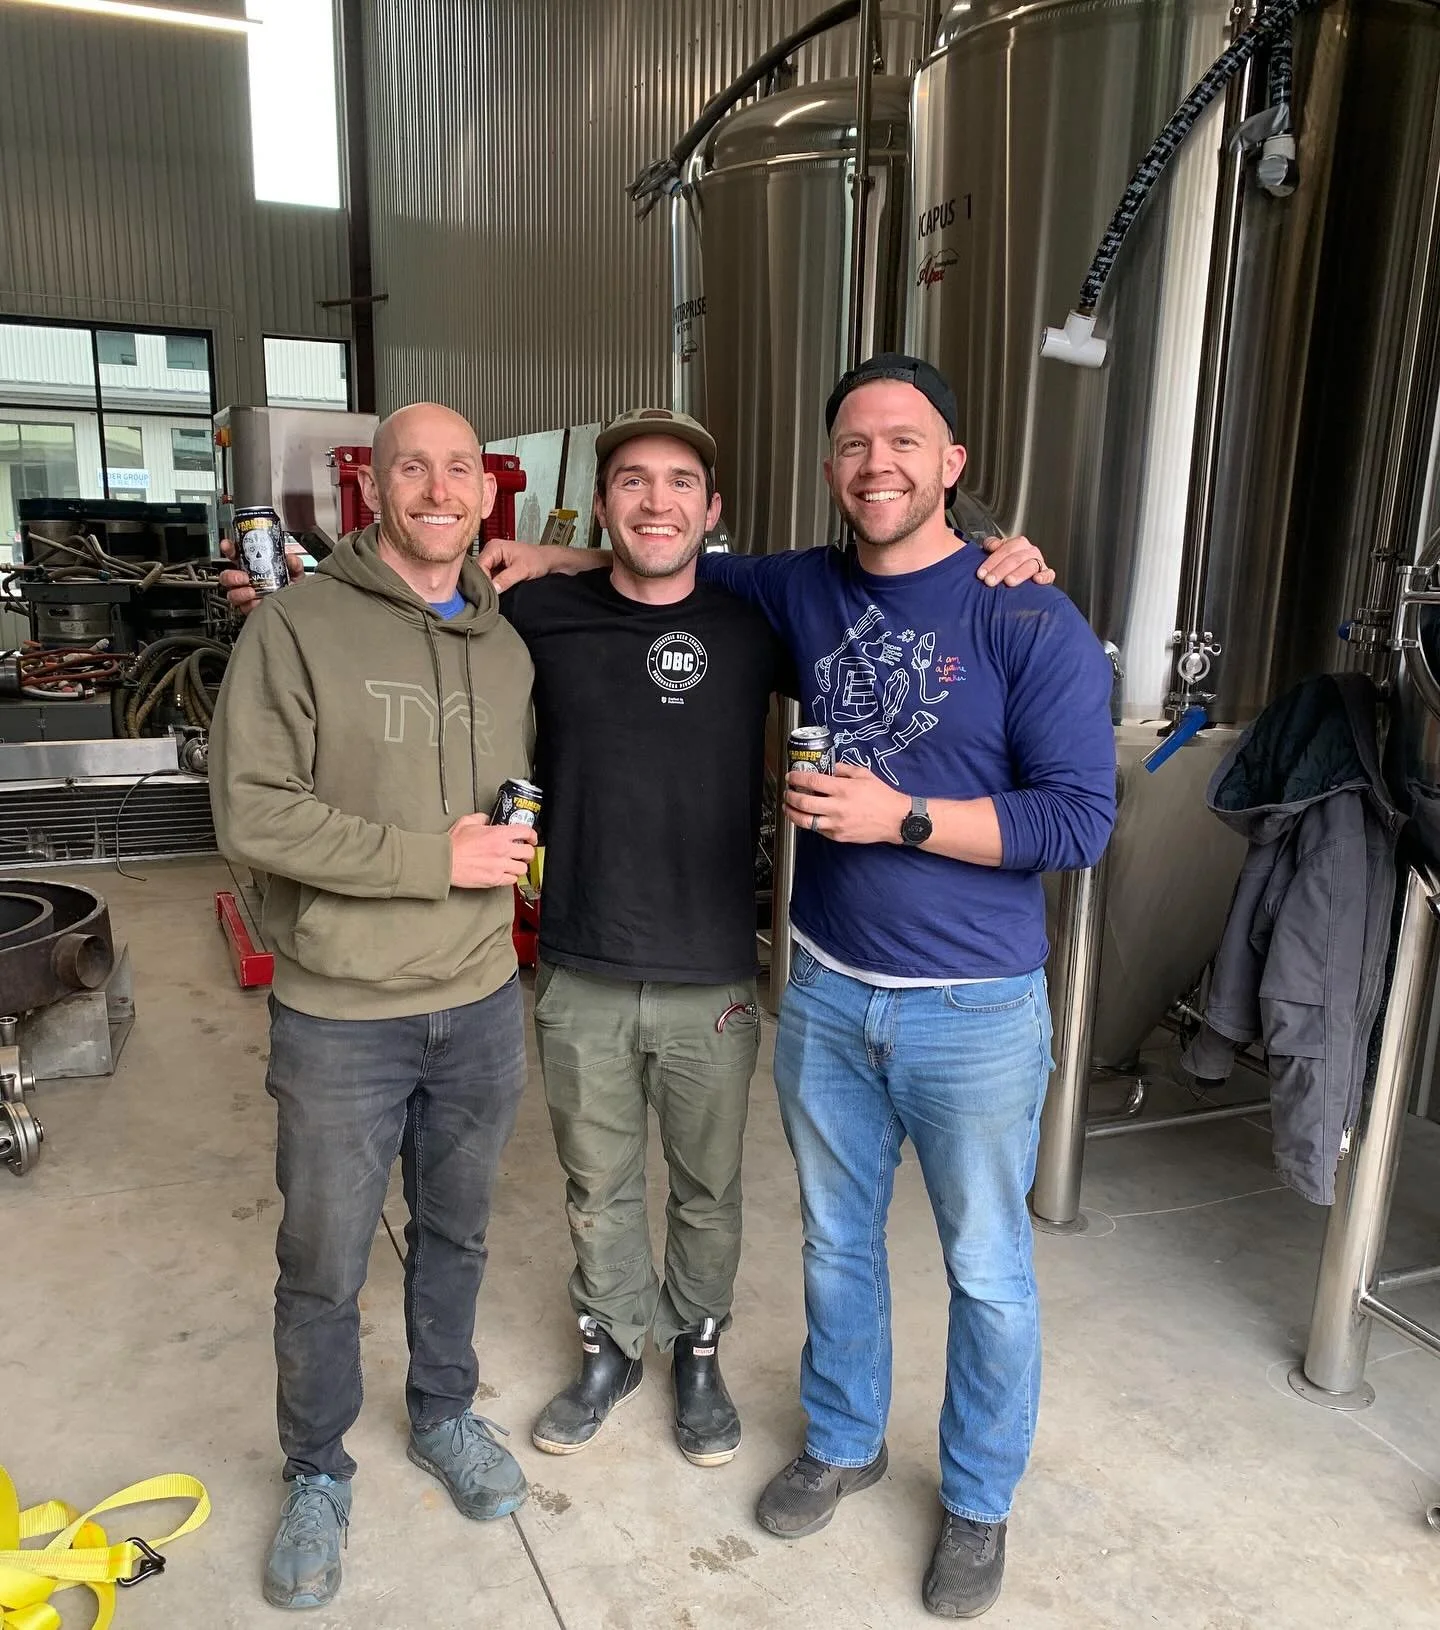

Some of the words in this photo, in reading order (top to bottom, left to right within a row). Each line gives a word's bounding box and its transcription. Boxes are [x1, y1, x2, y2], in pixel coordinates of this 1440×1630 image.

[123, 473, 149, 481] GROUP
[661, 650, 694, 671] DBC
[946, 656, 961, 664] am
[365, 679, 497, 757] TYR
